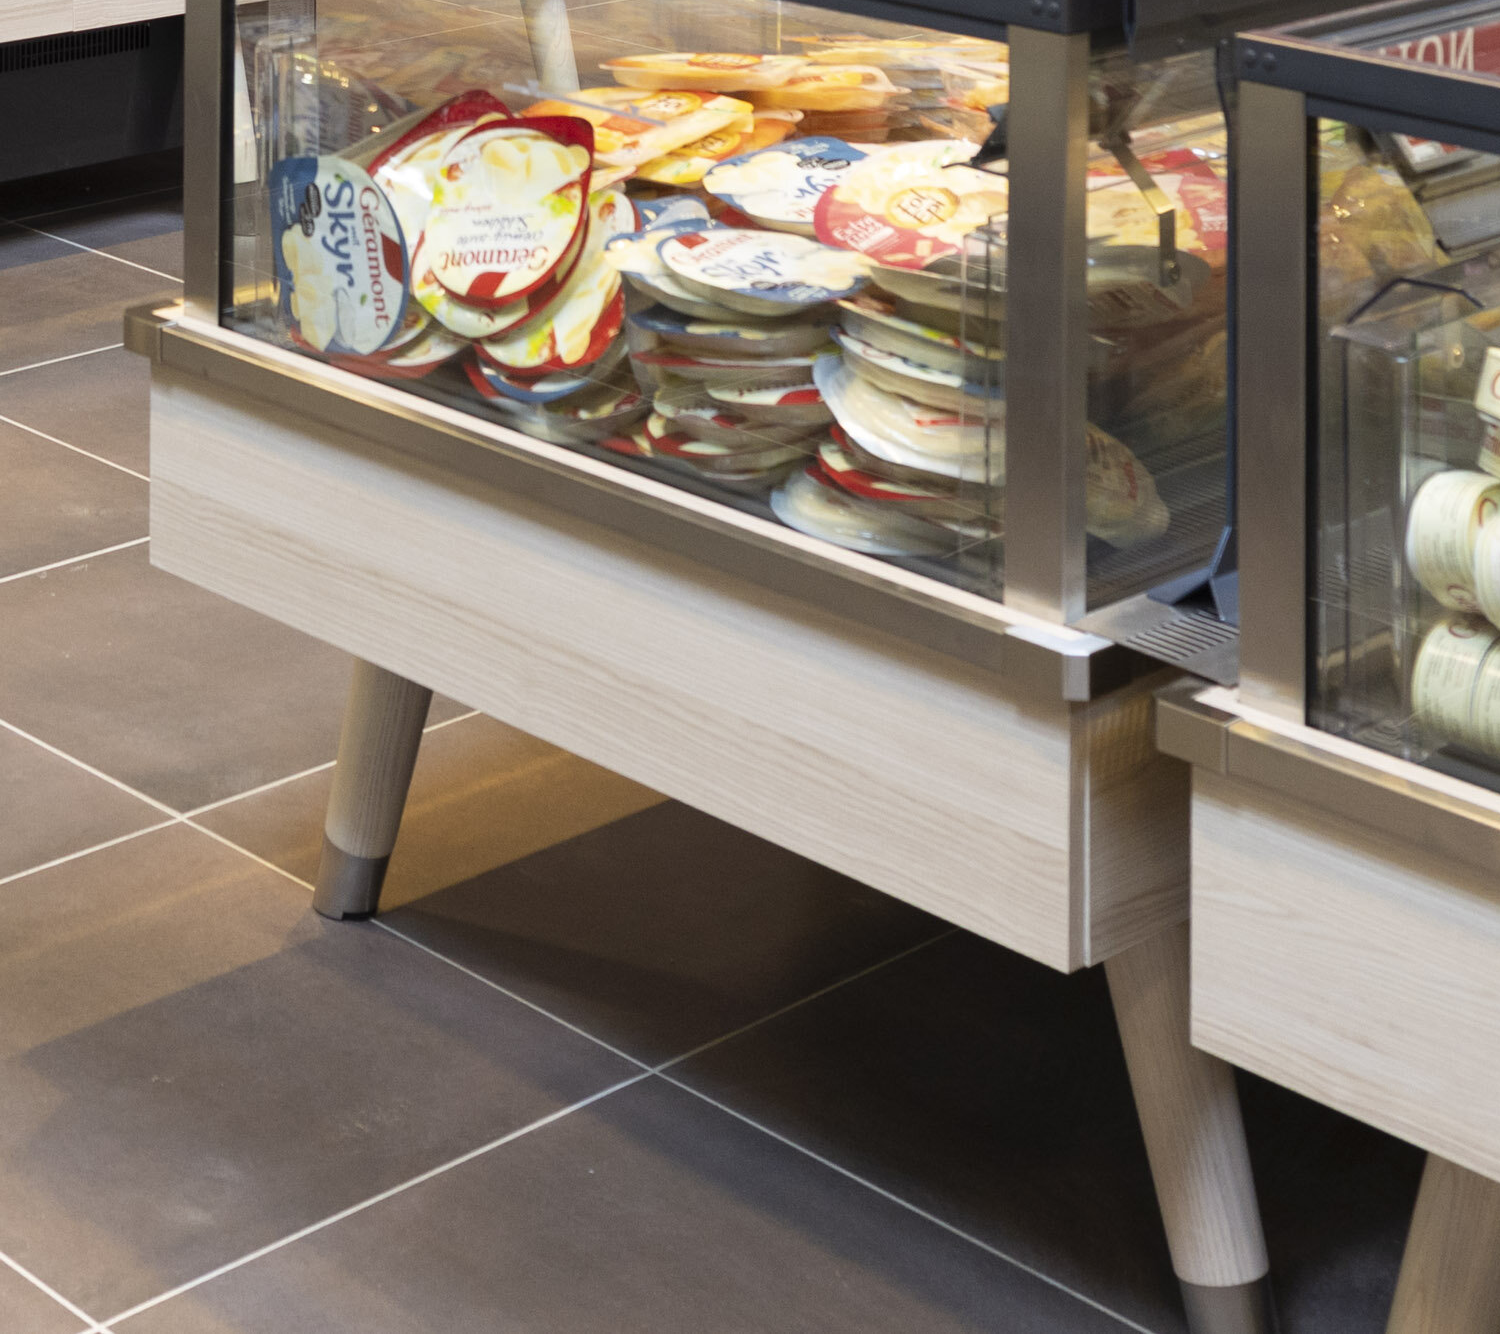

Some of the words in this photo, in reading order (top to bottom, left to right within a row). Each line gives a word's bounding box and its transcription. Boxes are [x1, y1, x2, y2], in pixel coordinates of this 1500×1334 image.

[321, 179, 354, 291] Skyr
[357, 186, 392, 329] Géramont
[439, 243, 549, 275] Géramont
